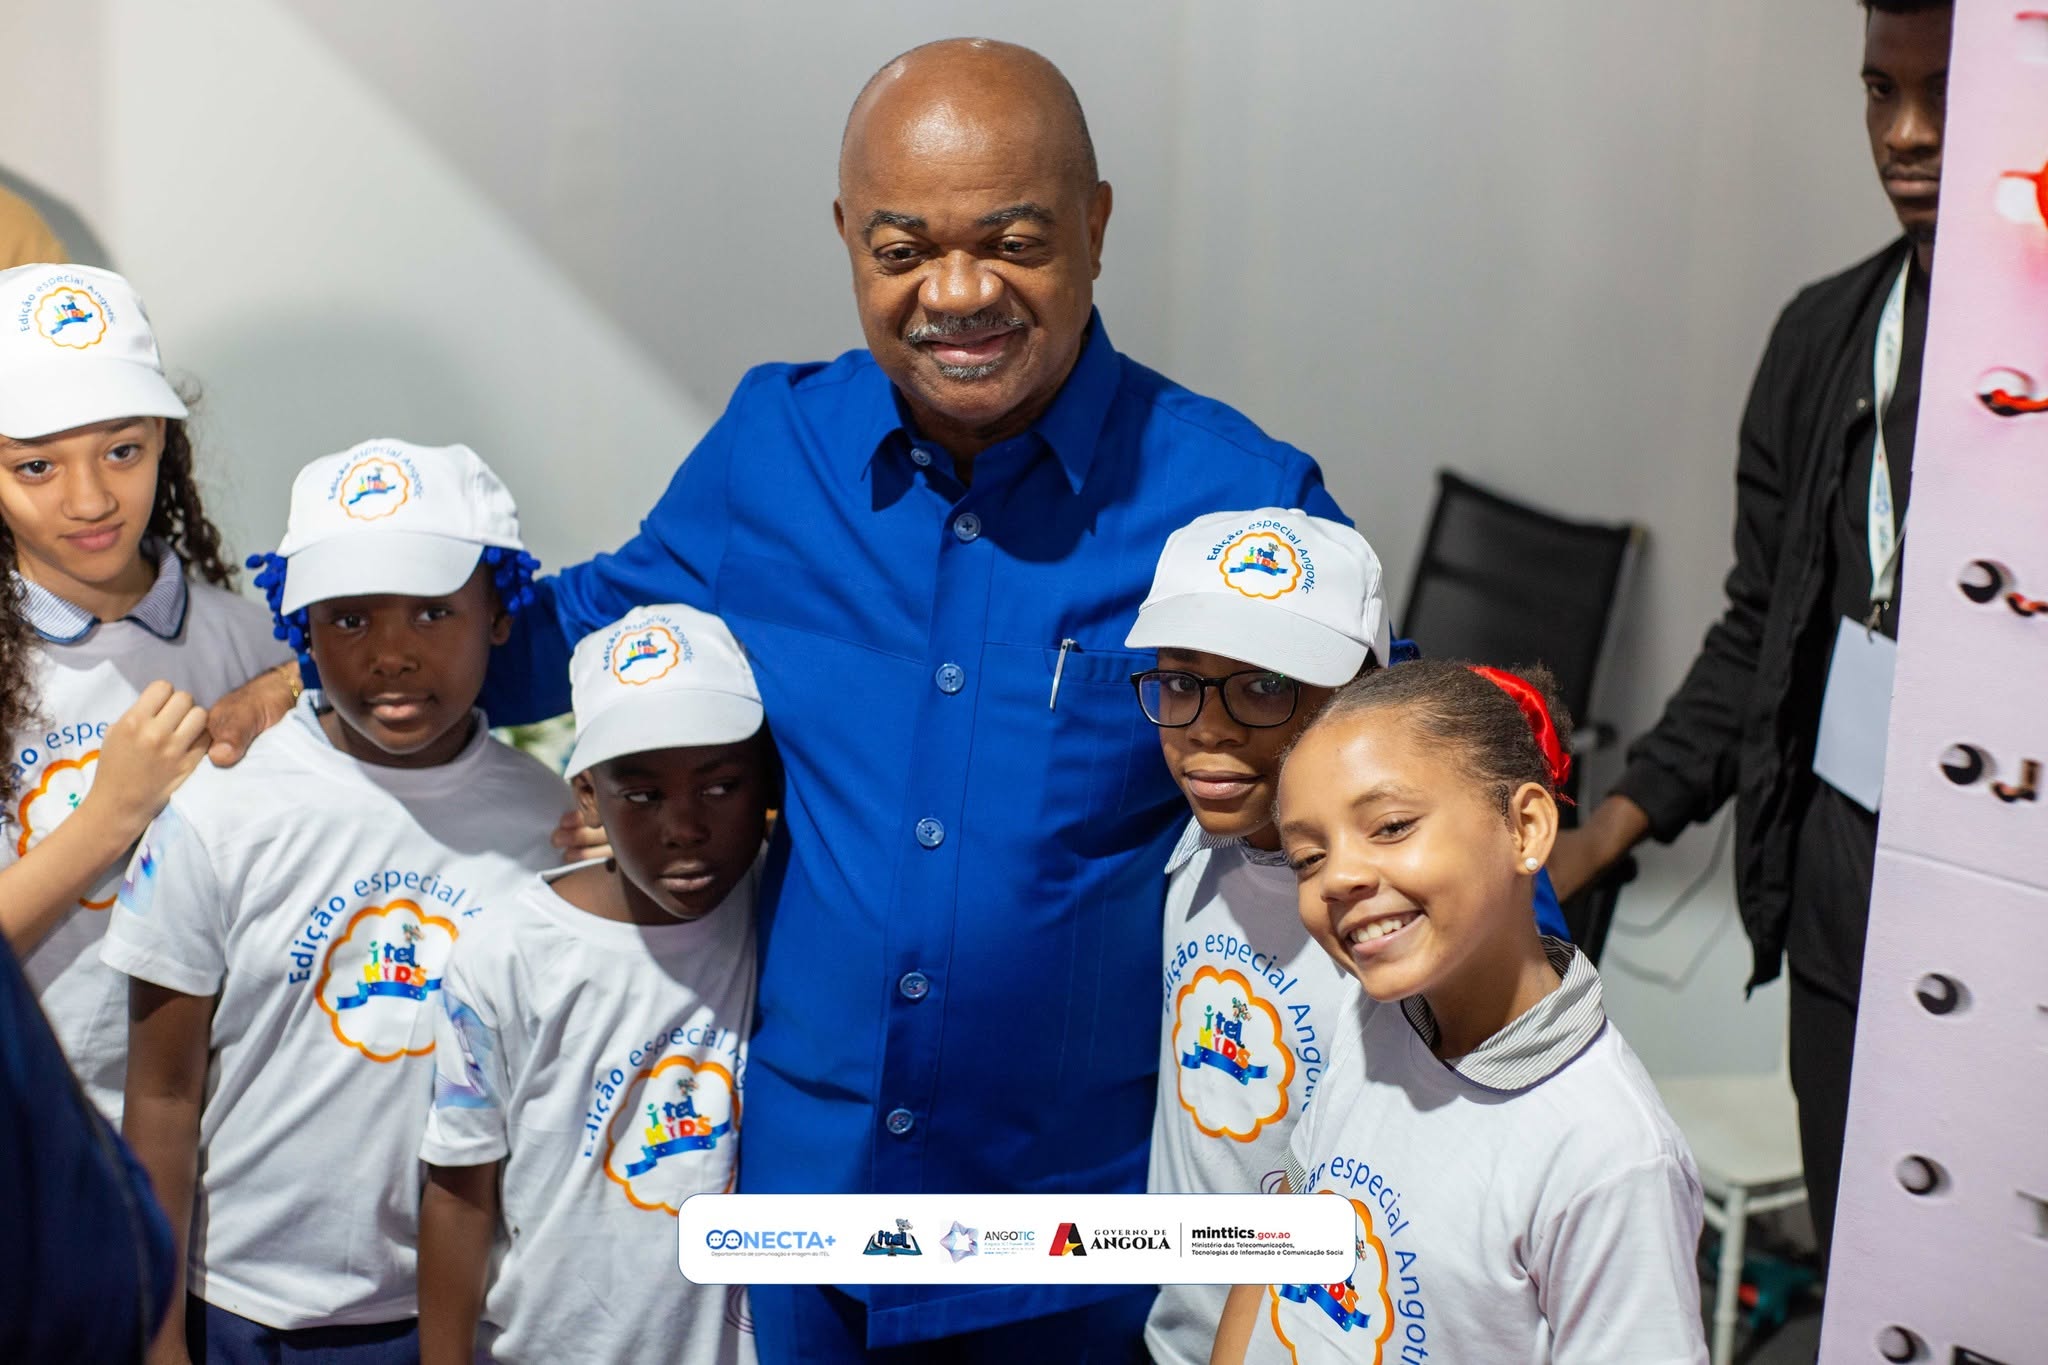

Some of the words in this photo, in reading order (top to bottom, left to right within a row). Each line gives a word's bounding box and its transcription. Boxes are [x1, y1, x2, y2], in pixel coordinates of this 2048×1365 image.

[1207, 529, 1243, 561] Edição
[1248, 520, 1302, 545] especial
[1298, 548, 1316, 594] Angotic
[46, 722, 108, 749] espe
[289, 896, 346, 985] Edição
[354, 870, 466, 908] especial
[1205, 934, 1298, 995] especial
[1330, 1156, 1410, 1238] especial
[1394, 1250, 1429, 1365] Angoti
